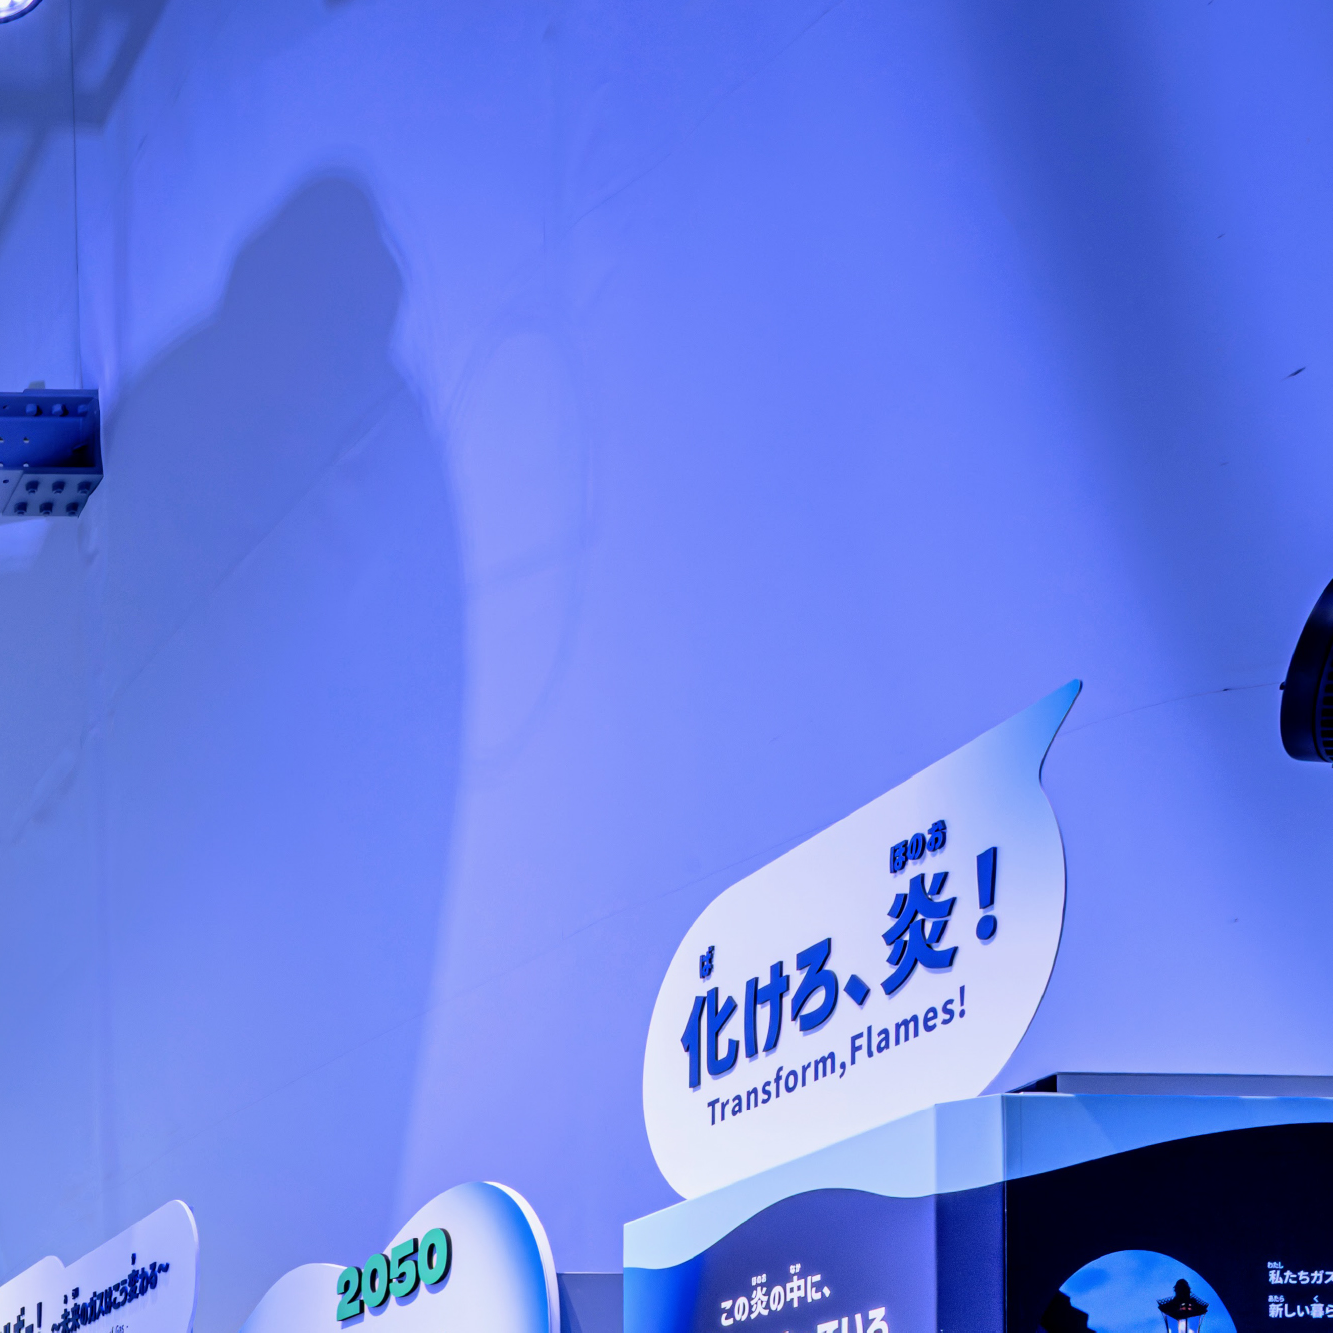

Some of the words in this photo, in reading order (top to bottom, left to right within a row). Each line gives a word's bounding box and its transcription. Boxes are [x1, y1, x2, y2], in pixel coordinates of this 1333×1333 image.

[680, 846, 998, 1089] 化けろ、炎！
[707, 985, 966, 1126] Transform,Flames!
[336, 1228, 453, 1322] 2050
[720, 1274, 831, 1327] この炎の中に、
